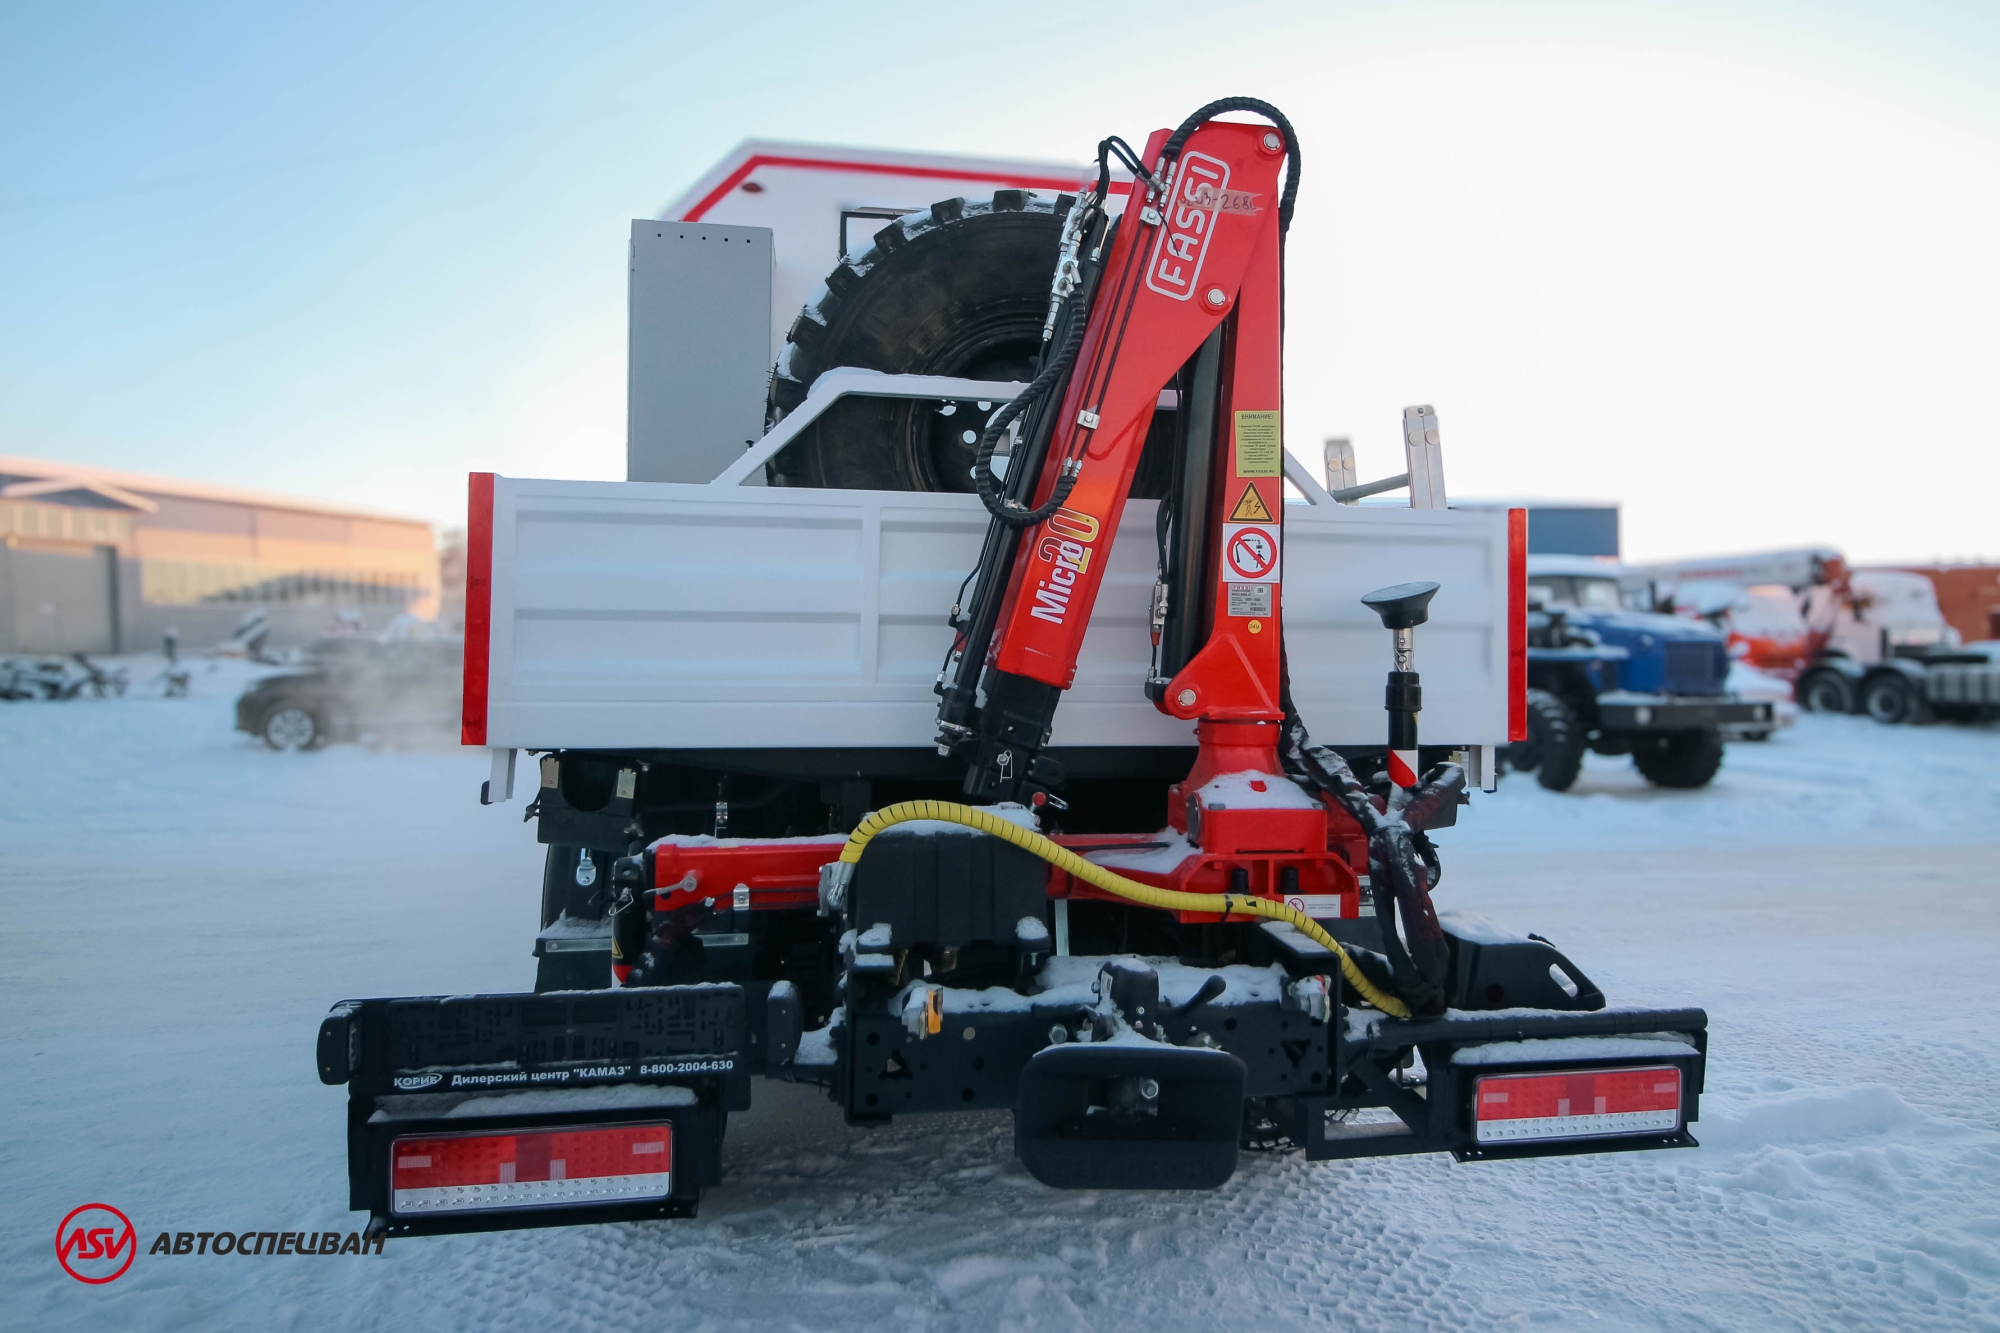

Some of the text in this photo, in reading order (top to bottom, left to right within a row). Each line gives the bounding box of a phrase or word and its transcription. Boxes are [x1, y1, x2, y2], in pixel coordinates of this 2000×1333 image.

[1157, 165, 1219, 287] FASSI
[1030, 506, 1100, 625] Micro 20
[393, 1060, 734, 1087] КОРИБ Дилерский центр "КАМАЗ" 8-800-2004-630
